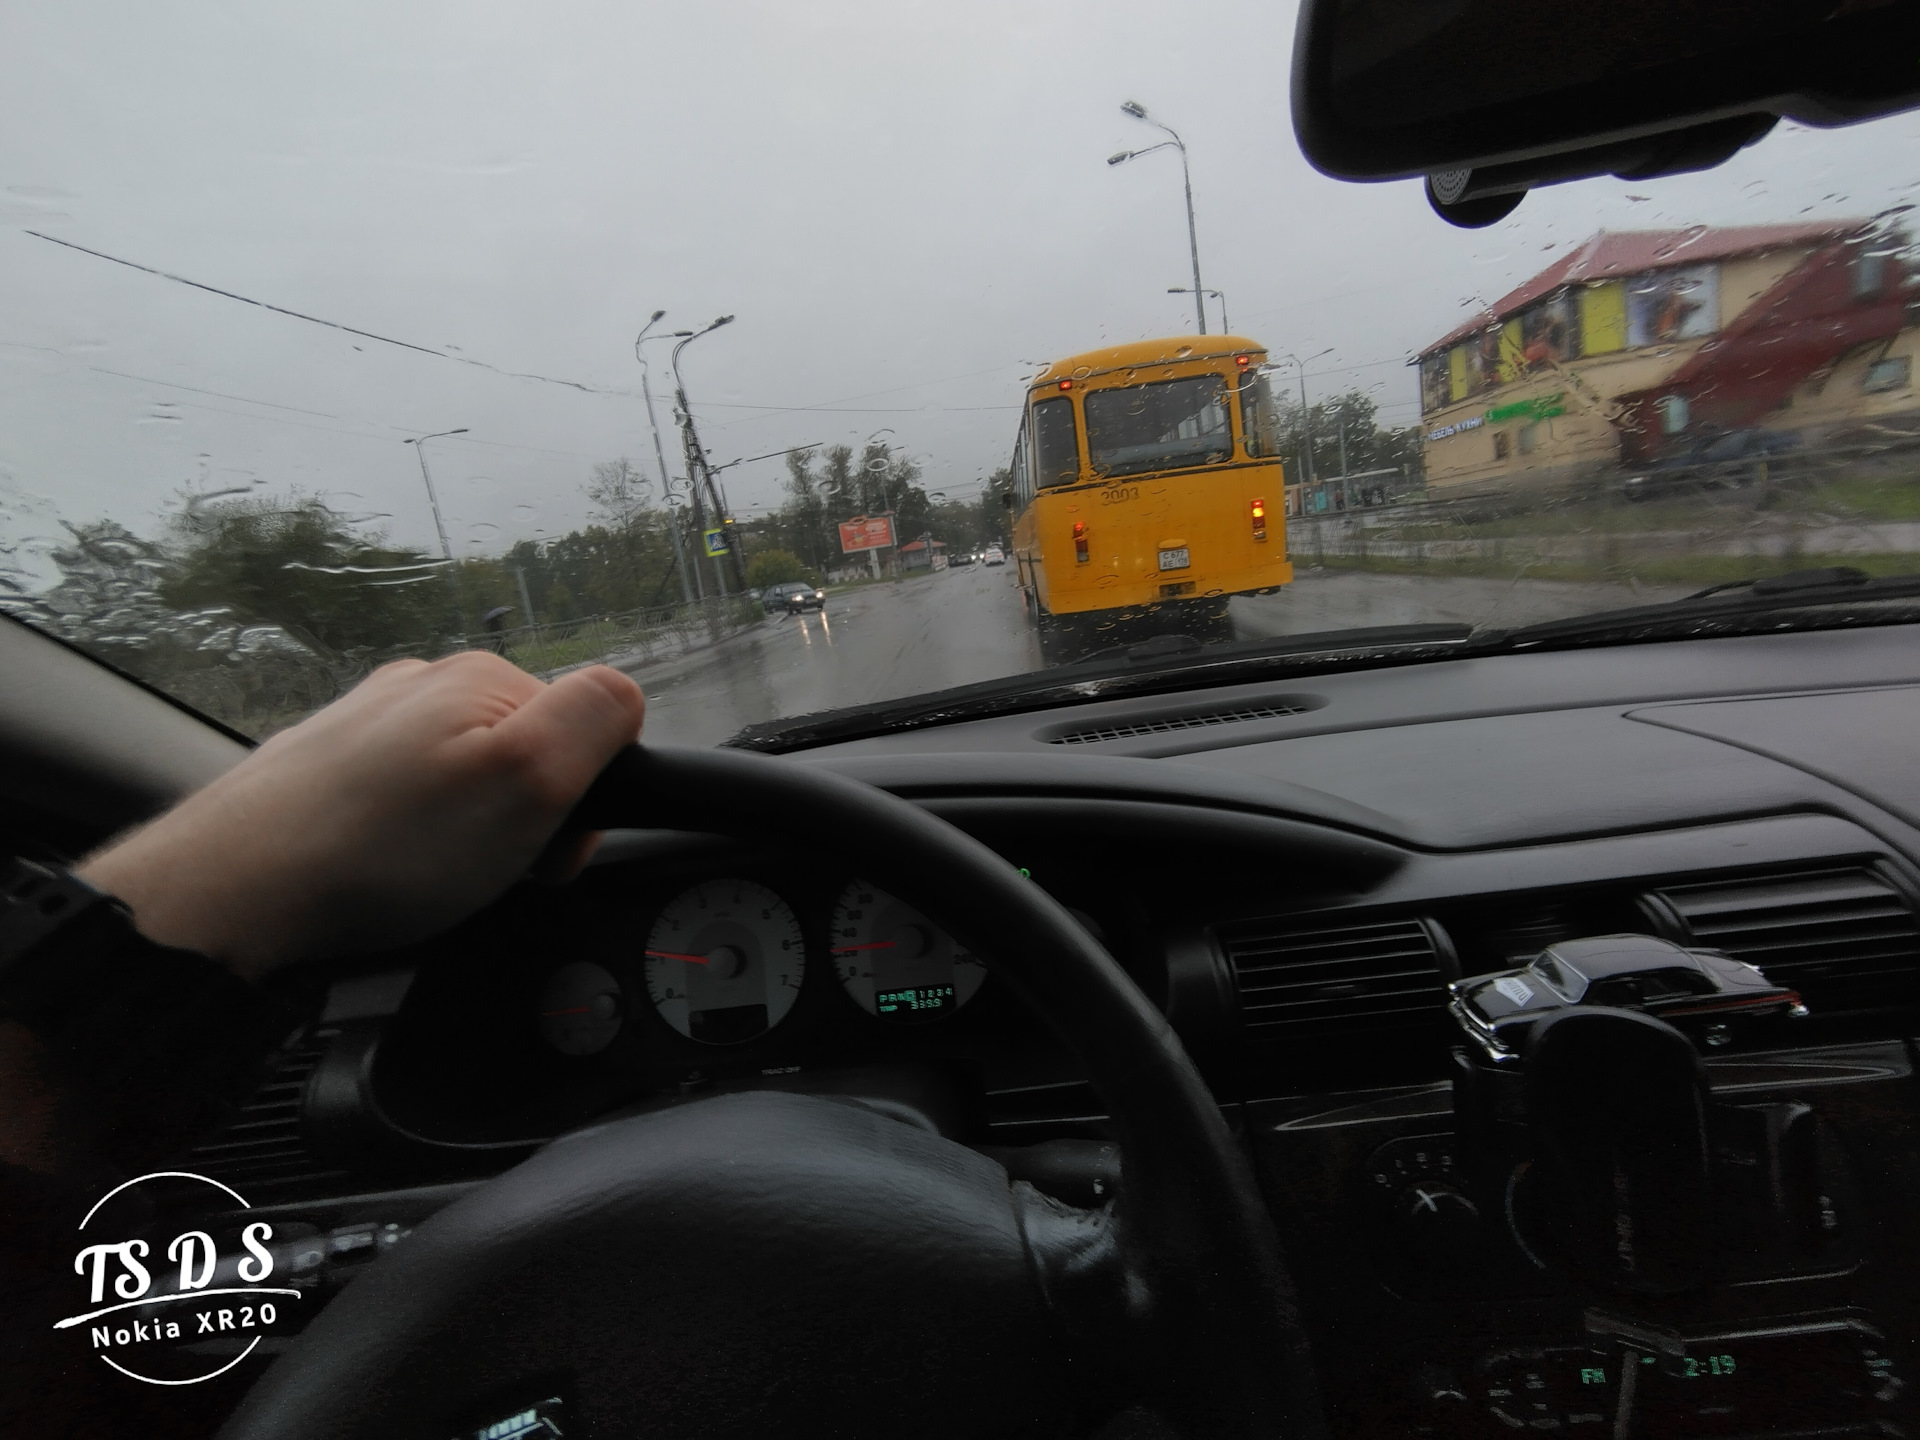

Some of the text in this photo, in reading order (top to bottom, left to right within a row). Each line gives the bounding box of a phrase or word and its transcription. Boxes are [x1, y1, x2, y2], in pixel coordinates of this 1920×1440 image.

[1428, 416, 1484, 441] МЕБЕЛЬ КУХНИ
[1580, 1354, 1737, 1385] FM 2:19
